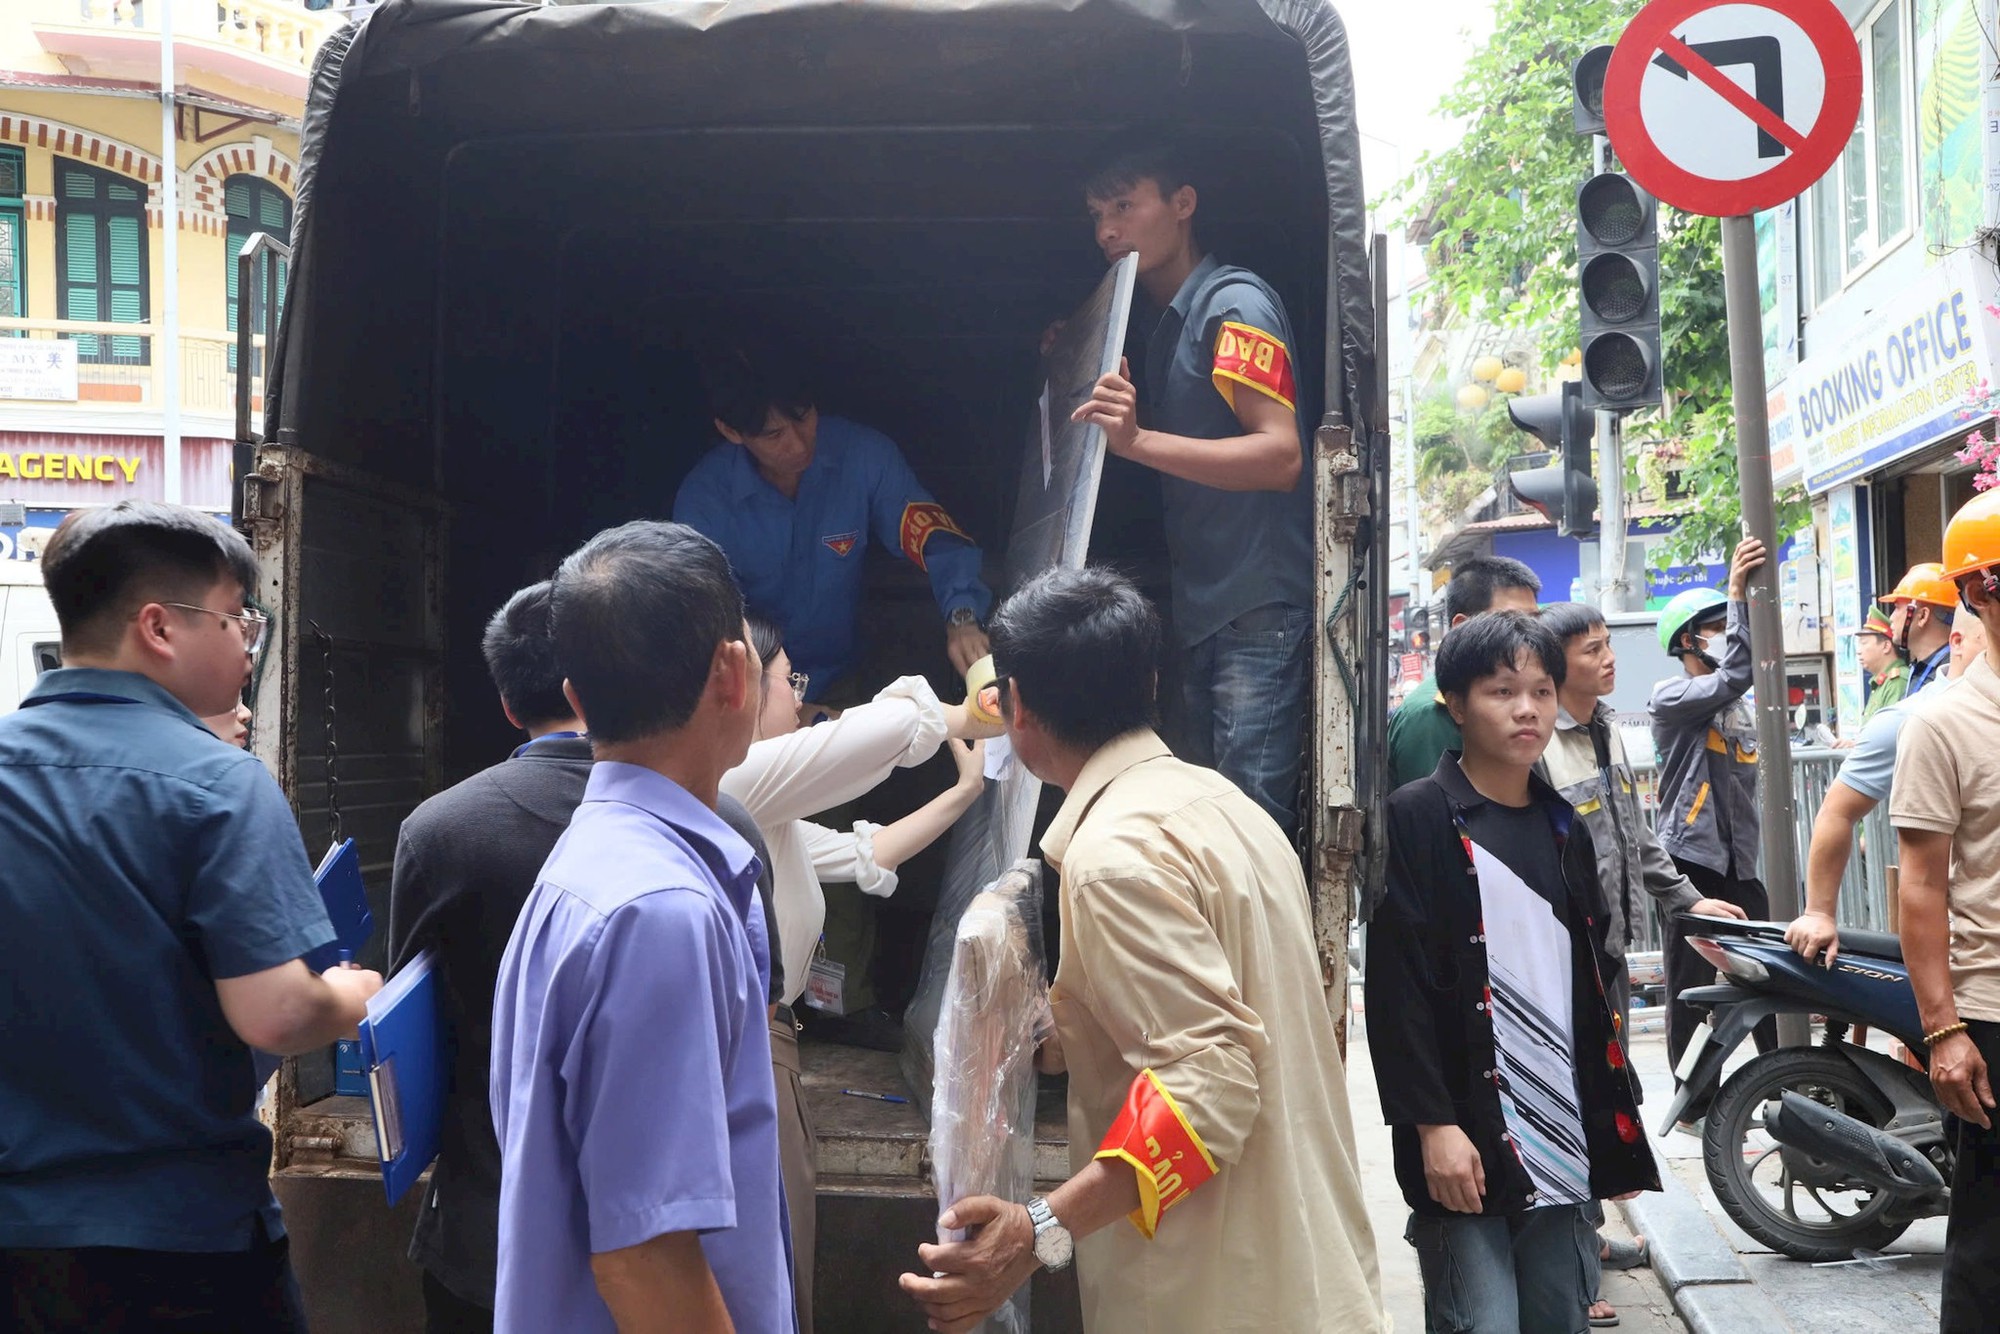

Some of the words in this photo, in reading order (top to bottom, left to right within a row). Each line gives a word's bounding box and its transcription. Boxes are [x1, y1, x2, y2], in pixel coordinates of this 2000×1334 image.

[1799, 350, 1883, 438] BOOKING
[1887, 291, 1971, 388] OFFICE
[1933, 360, 1979, 405] CENTER
[0, 453, 141, 483] AGENCY
